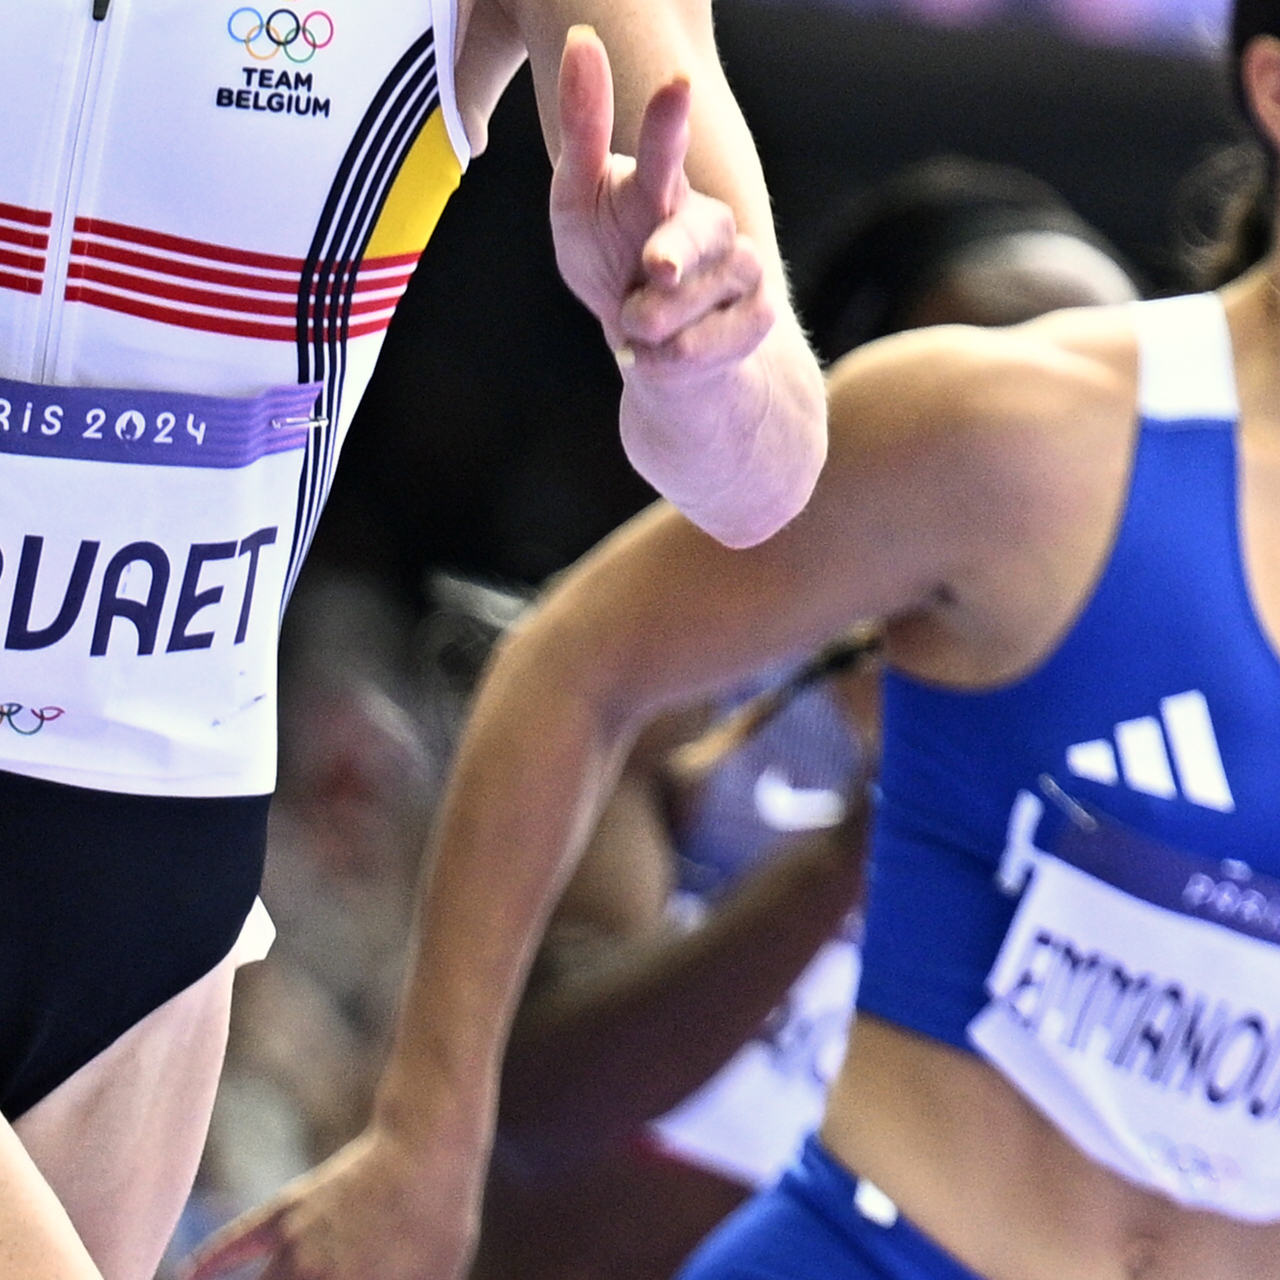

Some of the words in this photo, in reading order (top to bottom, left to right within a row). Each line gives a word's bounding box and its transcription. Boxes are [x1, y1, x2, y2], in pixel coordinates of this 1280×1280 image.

[242, 66, 314, 93] TEAM
[216, 86, 331, 119] BELGIUM
[81, 408, 208, 446] 2024
